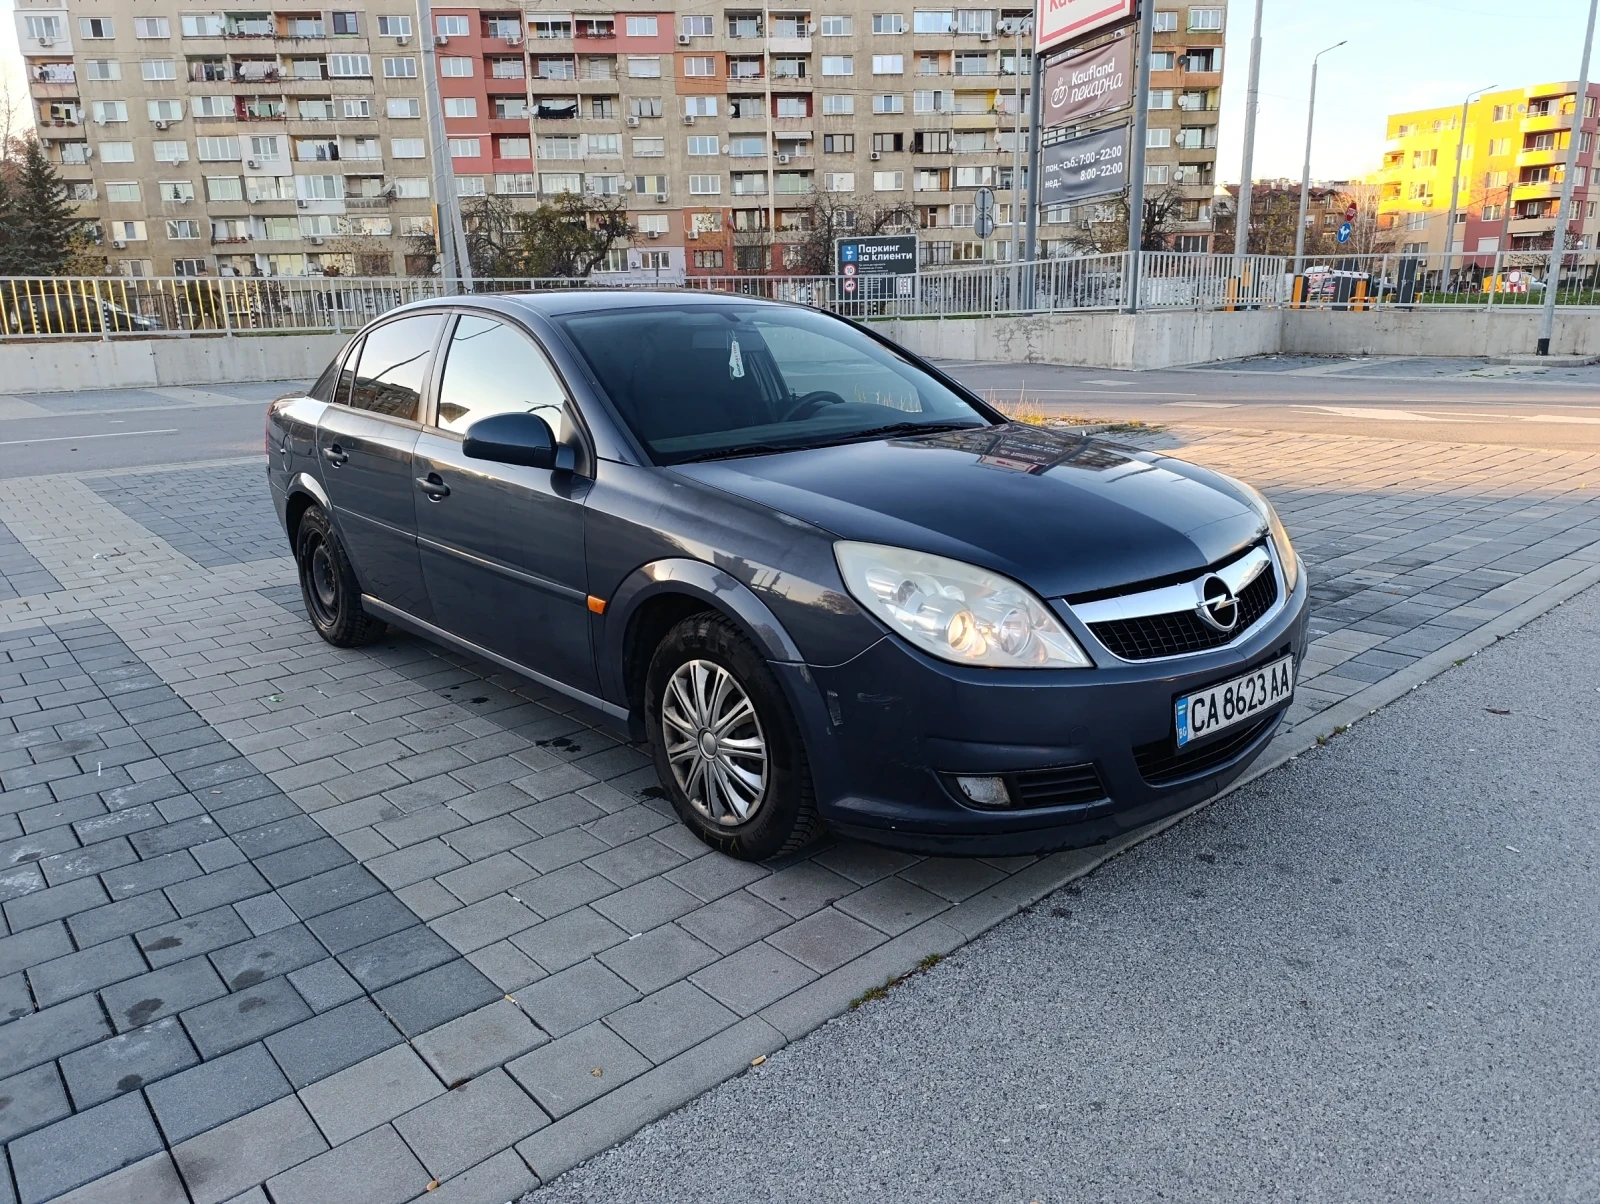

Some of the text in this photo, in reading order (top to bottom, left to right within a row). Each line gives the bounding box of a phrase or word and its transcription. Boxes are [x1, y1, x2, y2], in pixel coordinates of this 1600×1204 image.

[1071, 57, 1115, 86] Kaufland
[1070, 72, 1124, 103] пекарна
[858, 244, 900, 254] Паркинг
[858, 252, 913, 262] за клиенти
[1191, 663, 1289, 732] CA 8623 AA
